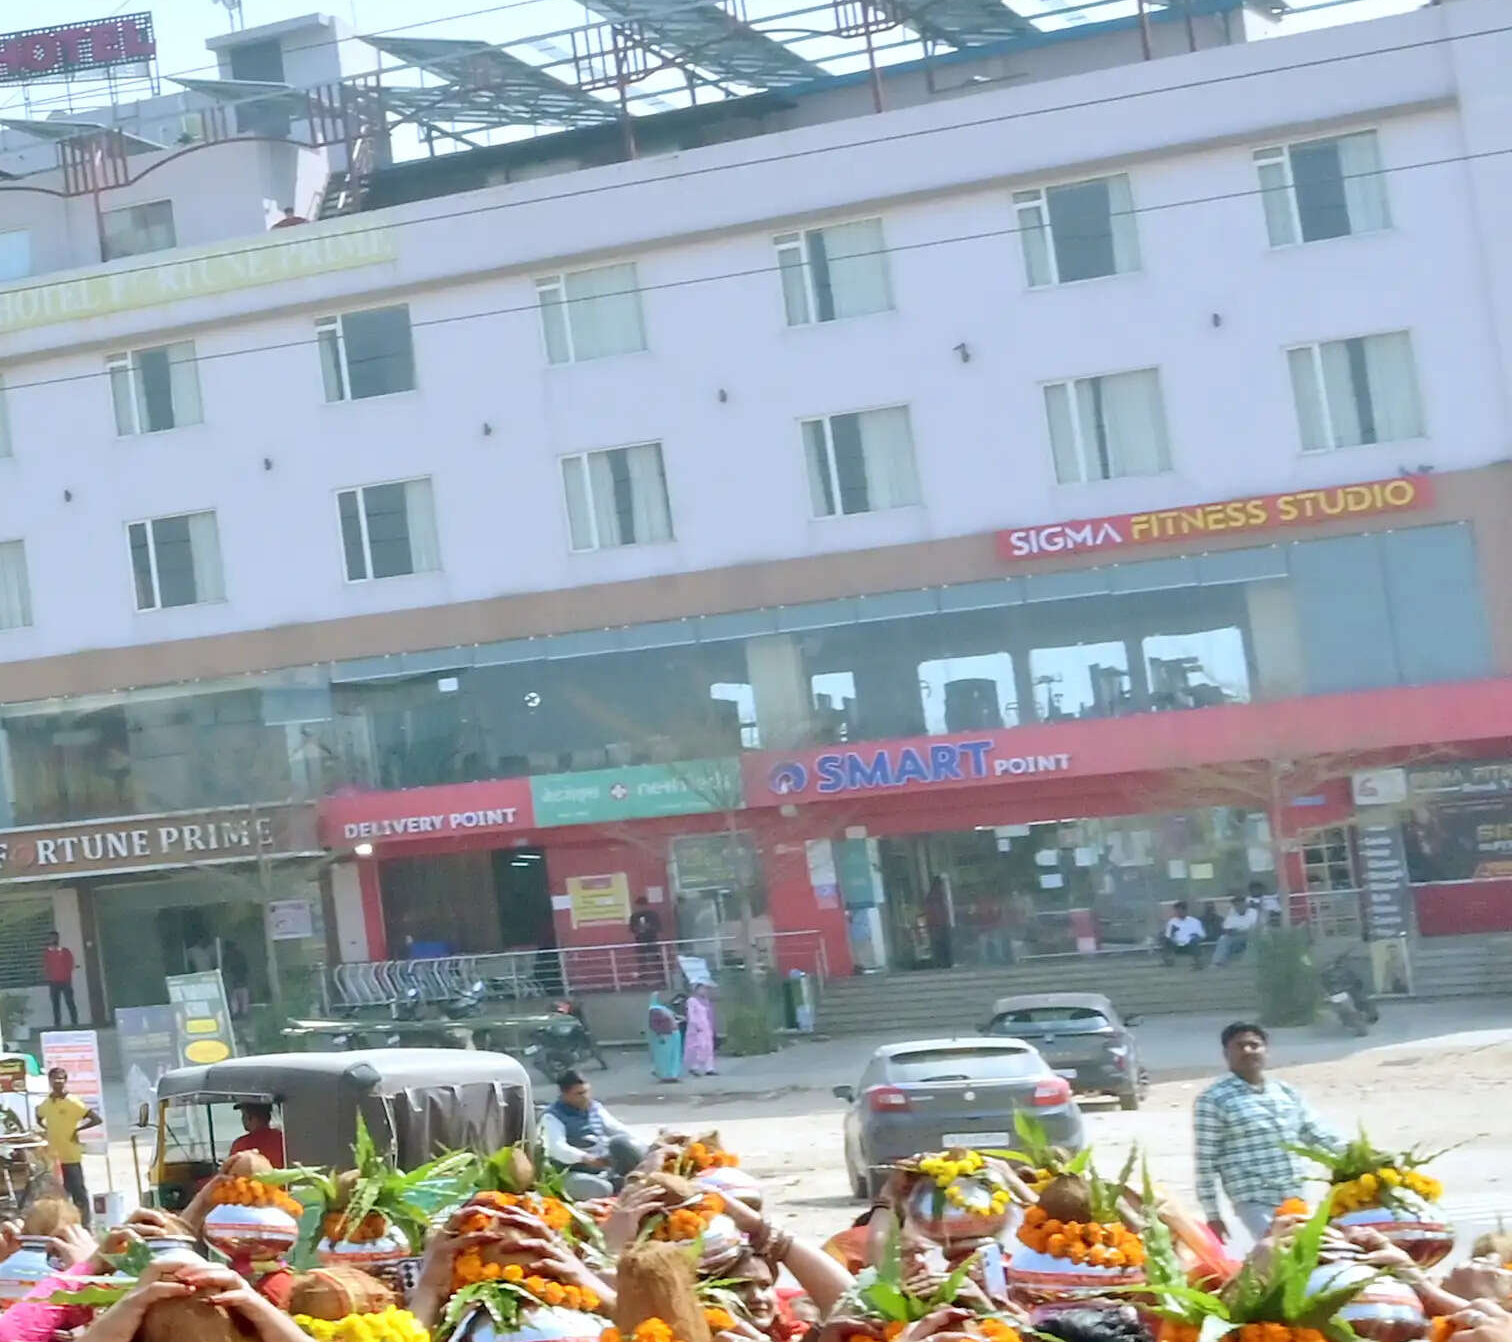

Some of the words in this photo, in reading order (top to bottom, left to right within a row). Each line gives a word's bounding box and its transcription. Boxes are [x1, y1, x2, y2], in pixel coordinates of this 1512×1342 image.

[1009, 523, 1122, 556] SIGMA
[1131, 499, 1267, 541] FITNESS
[1276, 480, 1415, 522] STUDIO
[816, 738, 994, 793] SMART
[994, 753, 1072, 777] POINT
[159, 817, 273, 854] PRIME
[344, 814, 444, 840] DELIVERY
[450, 807, 517, 828] POINT
